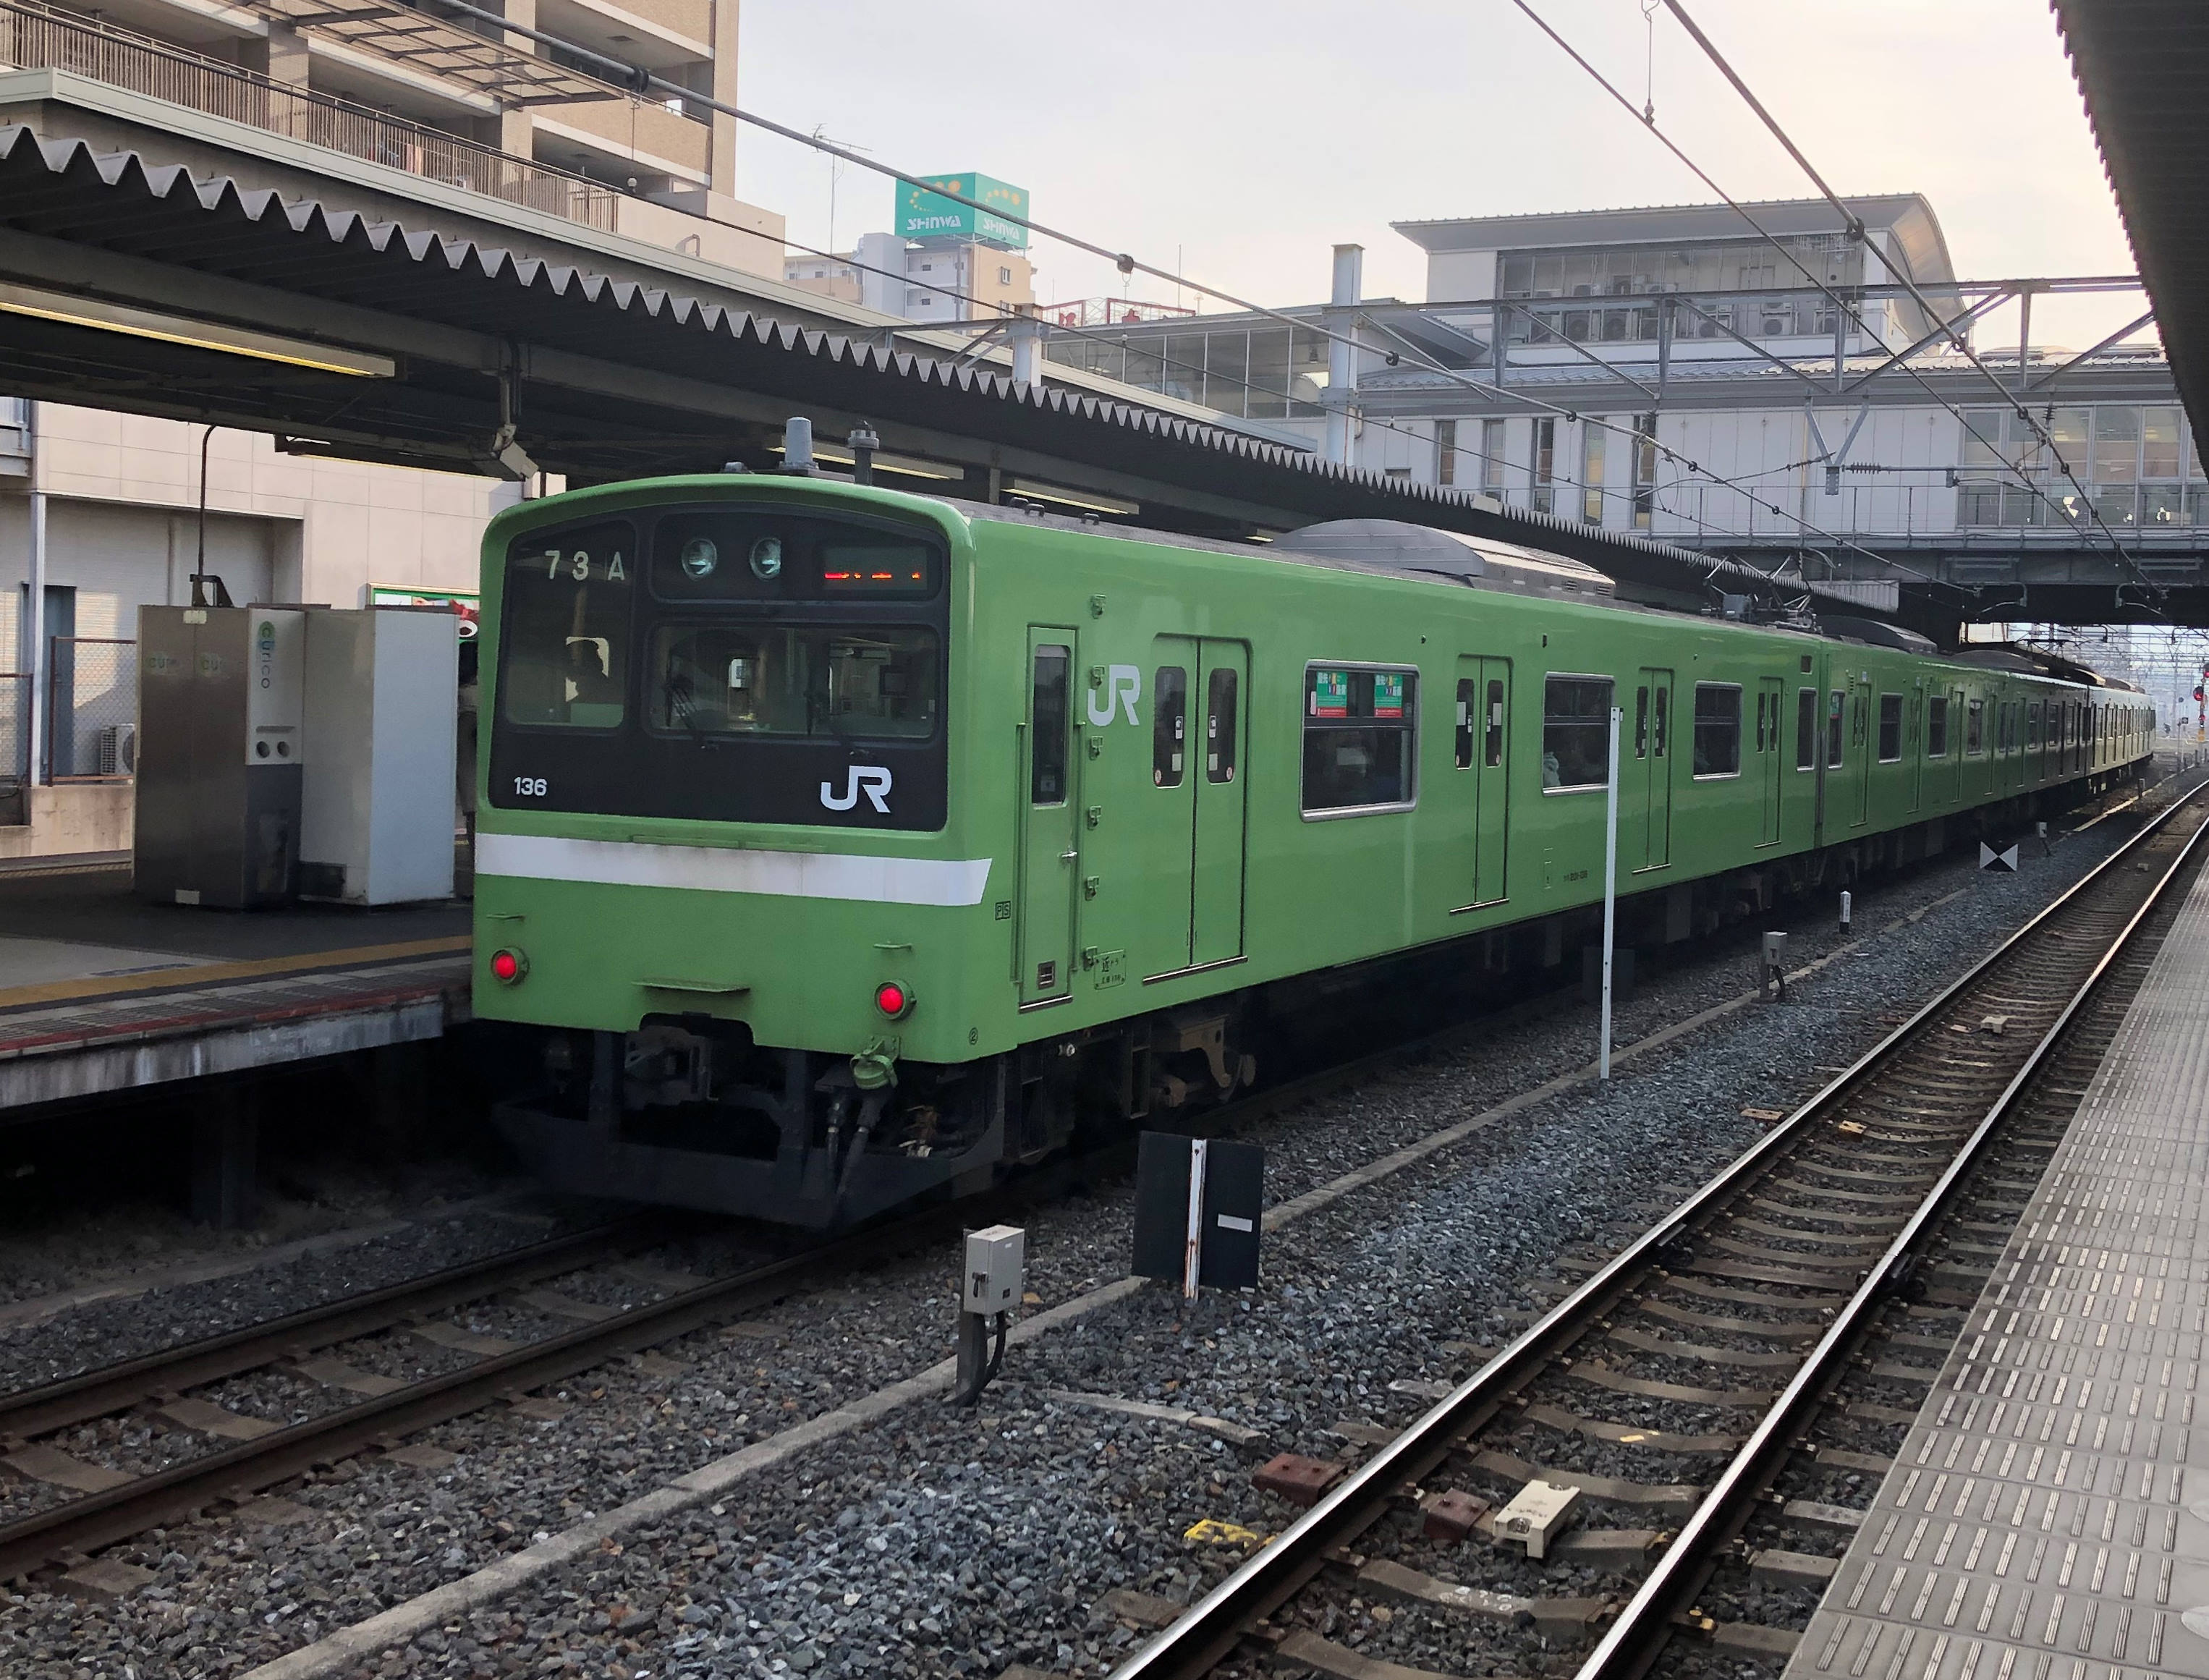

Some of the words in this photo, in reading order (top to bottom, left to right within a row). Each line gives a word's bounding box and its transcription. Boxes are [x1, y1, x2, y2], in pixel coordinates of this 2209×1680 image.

[1087, 663, 1142, 726] JR
[514, 776, 548, 797] 136
[820, 765, 892, 813] JR
